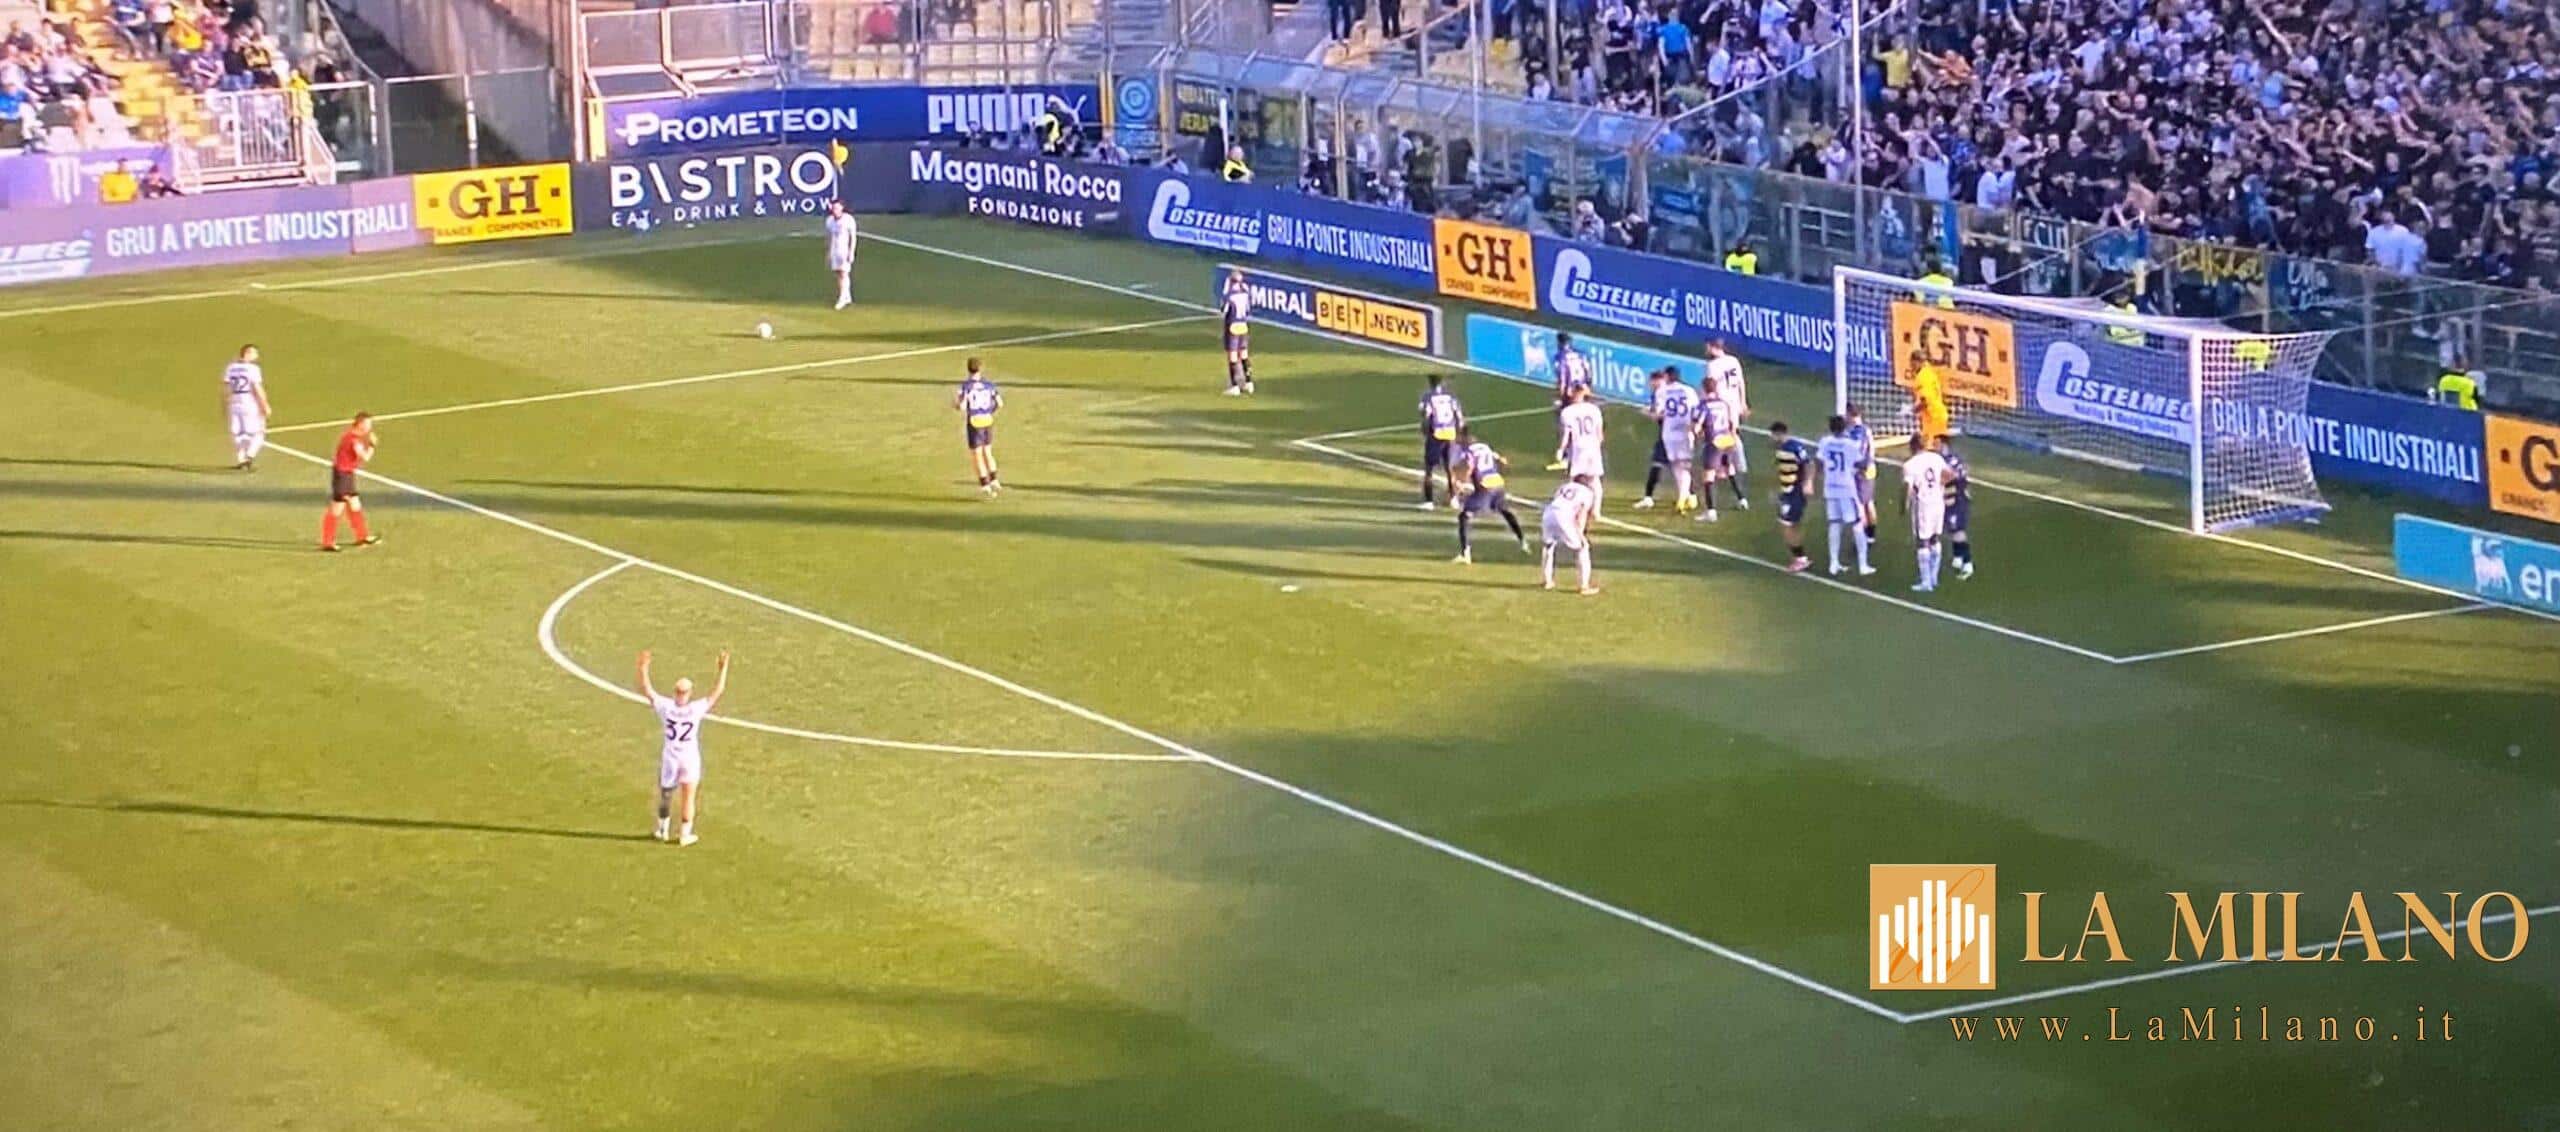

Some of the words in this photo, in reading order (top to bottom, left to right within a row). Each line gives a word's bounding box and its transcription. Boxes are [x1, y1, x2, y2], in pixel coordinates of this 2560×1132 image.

[616, 107, 858, 147] PROMETEON
[928, 92, 1045, 133] PUMA
[449, 174, 541, 220] GH
[910, 150, 1038, 192] Magnani
[1045, 163, 1122, 203] Rocca
[106, 223, 156, 257] GRU
[161, 223, 181, 254] A
[183, 214, 264, 250] PONTE
[265, 202, 409, 243] INDUSTRIALI
[674, 203, 740, 222] DRINK
[753, 200, 767, 216] &
[968, 195, 1084, 228] FONDAZIONE
[1149, 179, 1262, 241] COSTELMEC
[1267, 214, 1293, 247] GRU
[1296, 219, 1305, 248] A
[1306, 221, 1349, 258] PONTE
[1350, 224, 1434, 273] INDUSTRIALI
[1457, 230, 1516, 283] GH
[1250, 284, 1316, 321] MIRAL
[1551, 249, 1676, 316] COSTELMEC
[1685, 292, 1716, 329] GRU
[1719, 301, 1731, 330] A
[1733, 302, 1783, 344] PONTE
[1783, 313, 1887, 363] INDUSRIALI
[1919, 317, 1991, 378] GH
[1590, 345, 1646, 395] ilive
[1576, 415, 1594, 436] 10
[1665, 396, 1688, 418] 95
[2212, 396, 2251, 438] GRU
[2257, 406, 2270, 443] A
[2274, 409, 2342, 457] PONTE
[2344, 423, 2480, 483] INDUSTRIALI
[666, 718, 694, 742] 32
